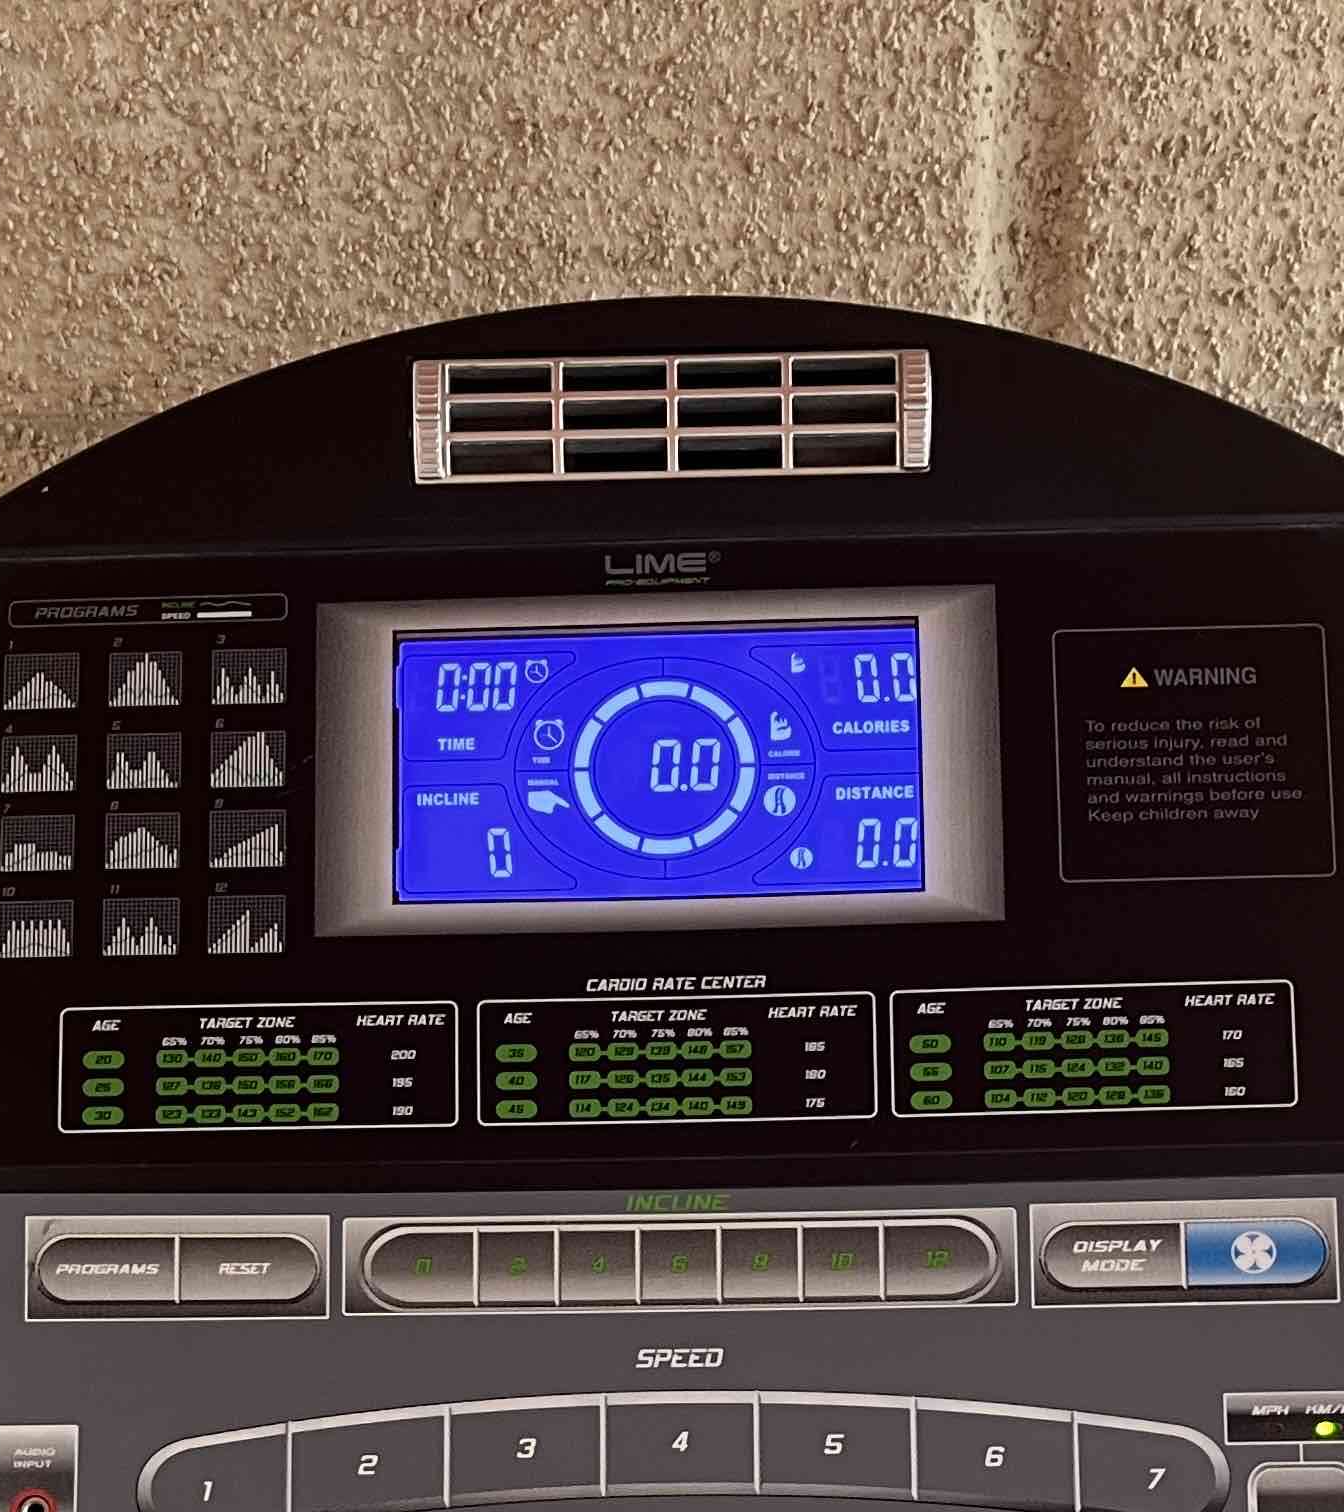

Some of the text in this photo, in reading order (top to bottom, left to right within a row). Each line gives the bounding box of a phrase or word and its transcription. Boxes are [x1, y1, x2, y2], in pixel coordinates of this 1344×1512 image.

[34, 604, 140, 619] PROGRAMS
[216, 634, 227, 644] 3
[854, 652, 917, 703] 0.0
[1154, 667, 1257, 687] WARNING
[436, 661, 518, 712] 0:00
[832, 719, 911, 735] CALORIES
[1085, 716, 1262, 733] To reduce the risk of
[437, 737, 476, 752] TIME
[1085, 737, 1149, 751] serious
[1210, 735, 1250, 748] read
[1256, 734, 1288, 747] and
[650, 738, 722, 793] 0.0
[1086, 752, 1275, 769] understand the user's
[1161, 772, 1182, 785] all
[1187, 770, 1287, 785] instructions
[416, 791, 480, 807] INCLINE
[835, 785, 915, 801] DISTANCE
[1088, 791, 1120, 805] and
[1125, 790, 1205, 806] warnings
[1209, 788, 1266, 802] before
[1088, 808, 1135, 824] Keep
[1139, 808, 1208, 821] children
[856, 816, 918, 869] 0.0
[487, 827, 513, 878] 0
[1, 887, 16, 897] 10
[109, 884, 120, 894] 11
[586, 974, 767, 993] CARDIO RATE CENTER
[917, 1002, 946, 1015] AGE
[1025, 997, 1123, 1012] TARGET ZONE
[1184, 993, 1276, 1008] HEART RATE
[356, 1013, 447, 1026] HEART RATE
[503, 1012, 533, 1024] AGE
[611, 1008, 707, 1022] TARGET ZONE
[768, 1004, 858, 1019] HEART RATE
[92, 1019, 121, 1031] AGE
[199, 1016, 296, 1030] TARGET ZONE
[1027, 1018, 1052, 1028] 70%
[612, 1029, 637, 1039] 70%
[1222, 1029, 1243, 1041] 170
[390, 1049, 417, 1061] 200
[507, 1076, 525, 1087] 40
[625, 1193, 729, 1212] INCLINE
[1072, 1238, 1165, 1255] DISPLAY
[217, 1261, 272, 1275] RESET
[591, 1256, 608, 1274] 4
[831, 1253, 856, 1271] 10
[926, 1250, 952, 1270] 12
[1081, 1258, 1147, 1273] MODE
[56, 1262, 161, 1275] PROGRAMS
[636, 1348, 724, 1369] SPEED
[1252, 1404, 1290, 1416] MPH
[516, 1437, 538, 1460] 3
[671, 1431, 689, 1453] 4
[822, 1433, 845, 1455] 5
[13, 1448, 56, 1457] AUDIO
[984, 1445, 1005, 1468] 6
[13, 1459, 52, 1468] INPUT
[357, 1454, 379, 1476] 2
[1147, 1467, 1167, 1491] 7
[203, 1480, 214, 1501] 1
